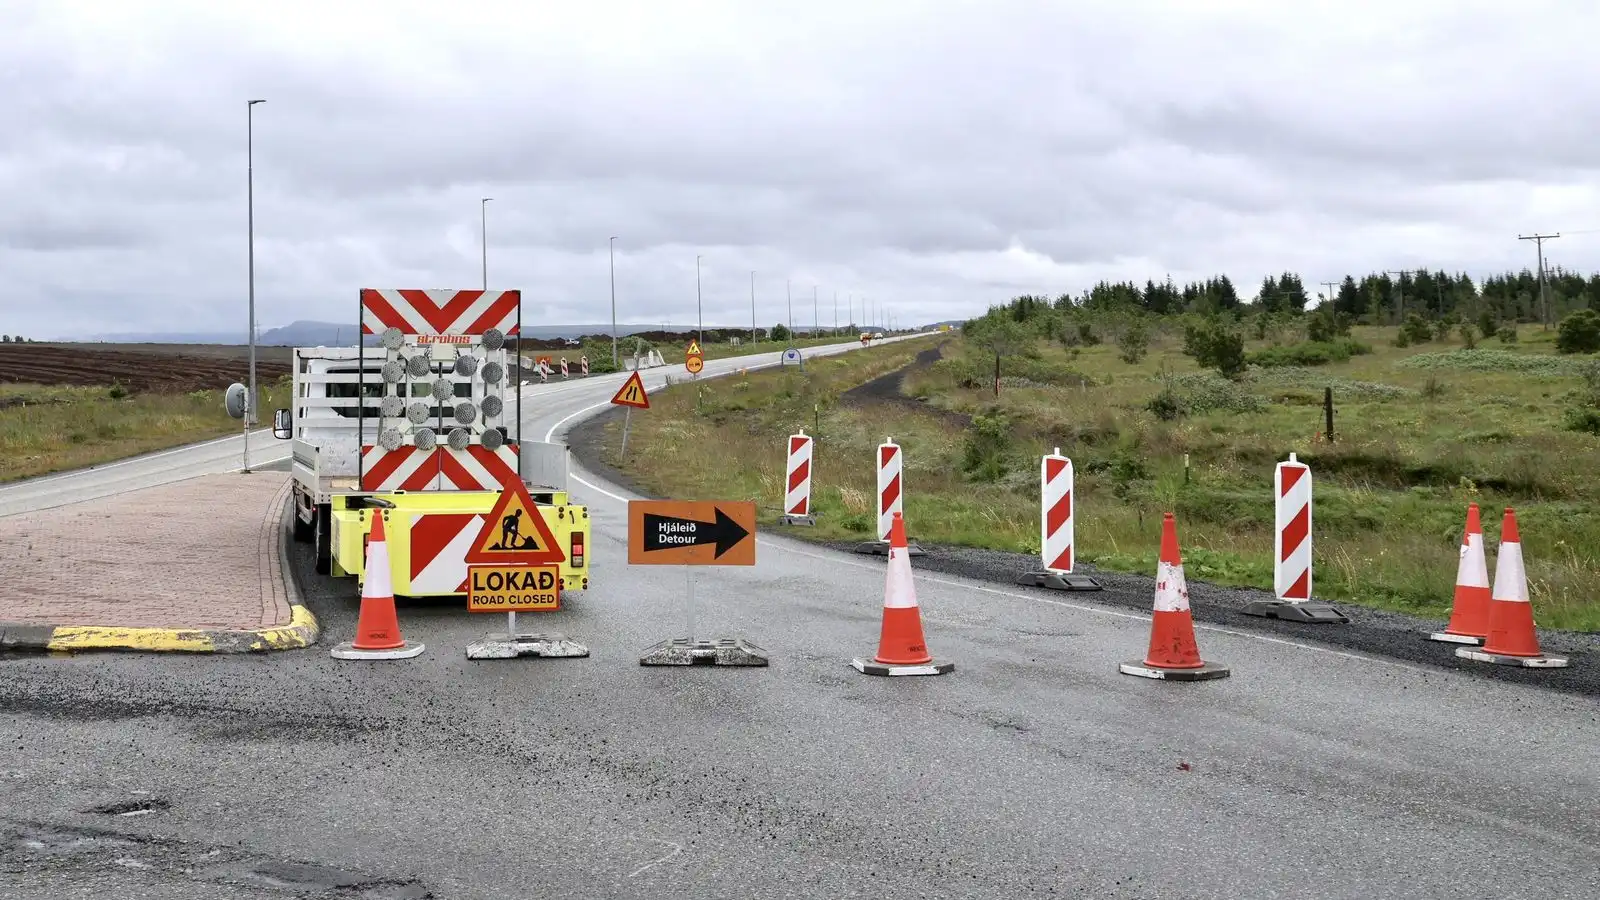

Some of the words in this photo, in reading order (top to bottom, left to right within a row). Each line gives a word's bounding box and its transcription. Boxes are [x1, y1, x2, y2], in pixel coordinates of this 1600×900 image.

[658, 522, 697, 534] Hjáleið
[658, 534, 697, 544] Detour
[473, 571, 555, 591] LOKAÐ
[473, 595, 505, 605] ROAD
[508, 594, 555, 604] CLOSED
